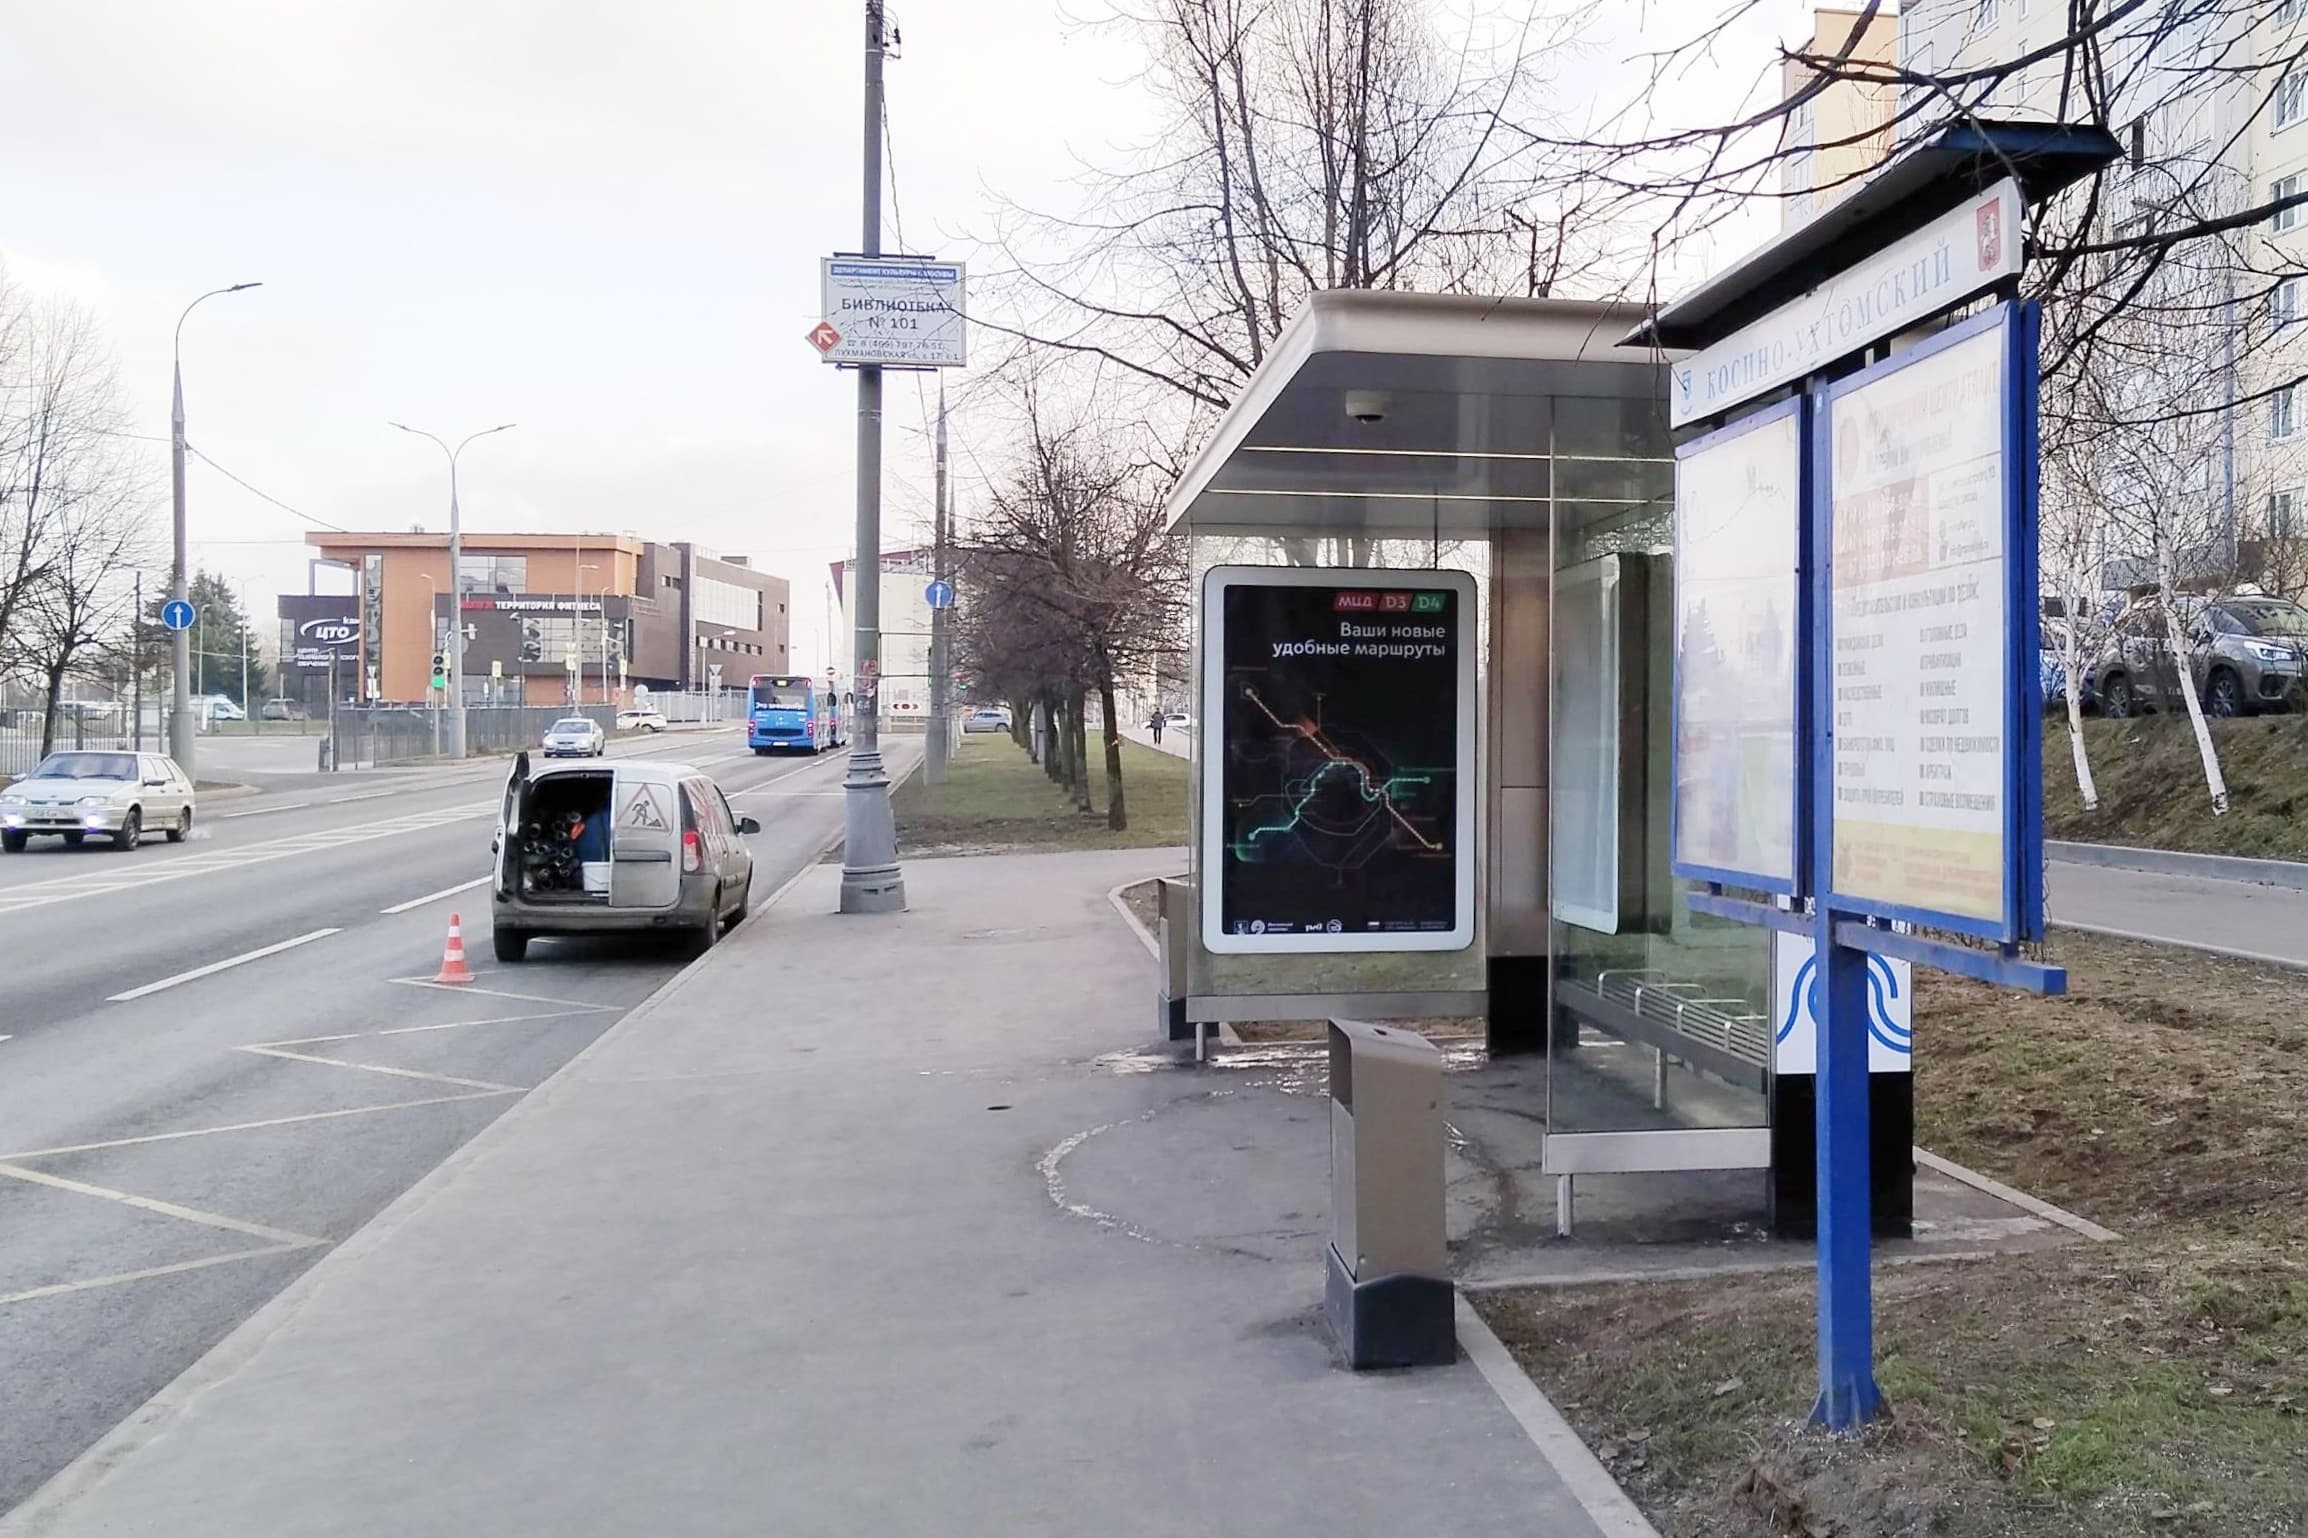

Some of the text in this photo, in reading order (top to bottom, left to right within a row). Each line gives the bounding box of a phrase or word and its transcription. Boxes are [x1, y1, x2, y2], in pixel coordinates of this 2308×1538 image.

[842, 298, 946, 313] БИБЛИОТЕКА
[891, 317, 918, 330] 101
[495, 600, 555, 610] ТЕРРИТОРИЯ
[1418, 596, 1440, 609] D4
[315, 626, 350, 640] ЦТО
[1340, 621, 1446, 638] Ваши новые
[1272, 638, 1446, 659] удобные маршруты
